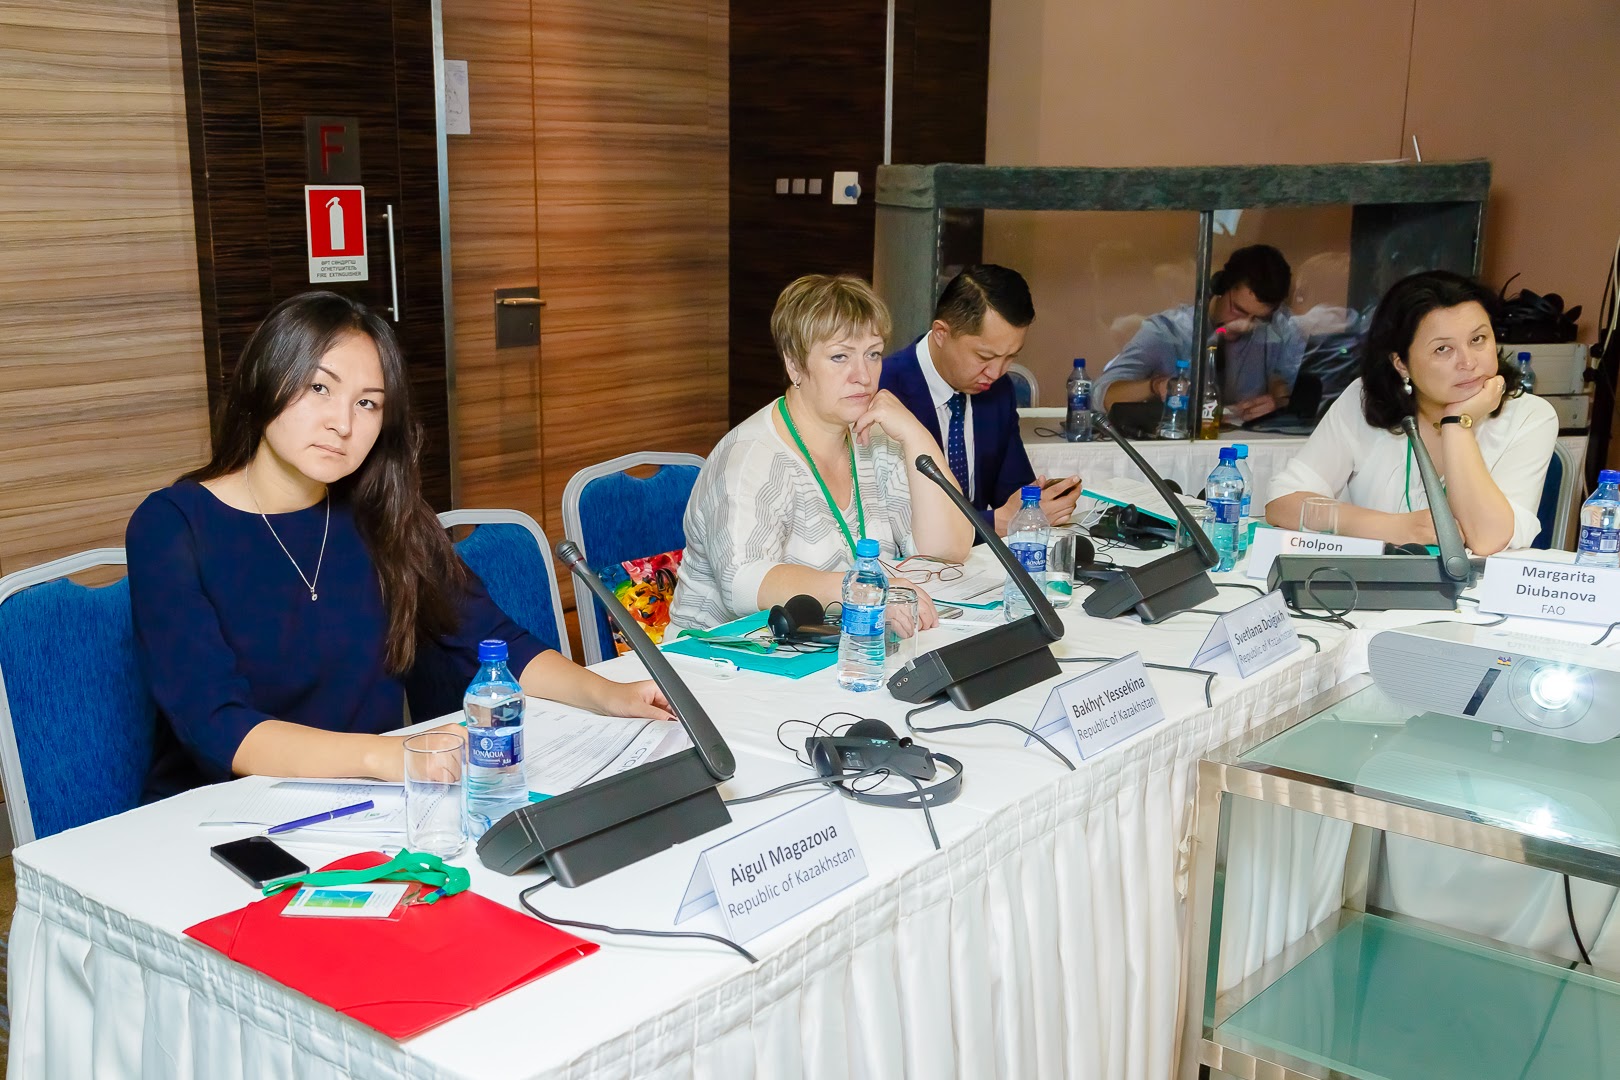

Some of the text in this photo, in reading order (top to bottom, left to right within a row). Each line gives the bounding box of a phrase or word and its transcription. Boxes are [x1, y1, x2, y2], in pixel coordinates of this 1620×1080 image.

[319, 124, 346, 175] F
[1290, 536, 1343, 552] Cholpon
[1522, 566, 1596, 584] Margarita
[1516, 584, 1596, 602] Diubanova
[1541, 604, 1566, 616] FAO
[1234, 624, 1263, 645] Svetlana
[1238, 646, 1263, 664] Republic
[1262, 640, 1269, 652] of
[1072, 677, 1146, 718] Bakhyt Yessekina
[1077, 696, 1156, 741] Republic of Kazakhstan
[730, 825, 838, 887] Aigul Magazova
[727, 847, 856, 918] Republic of Kazakhstan
